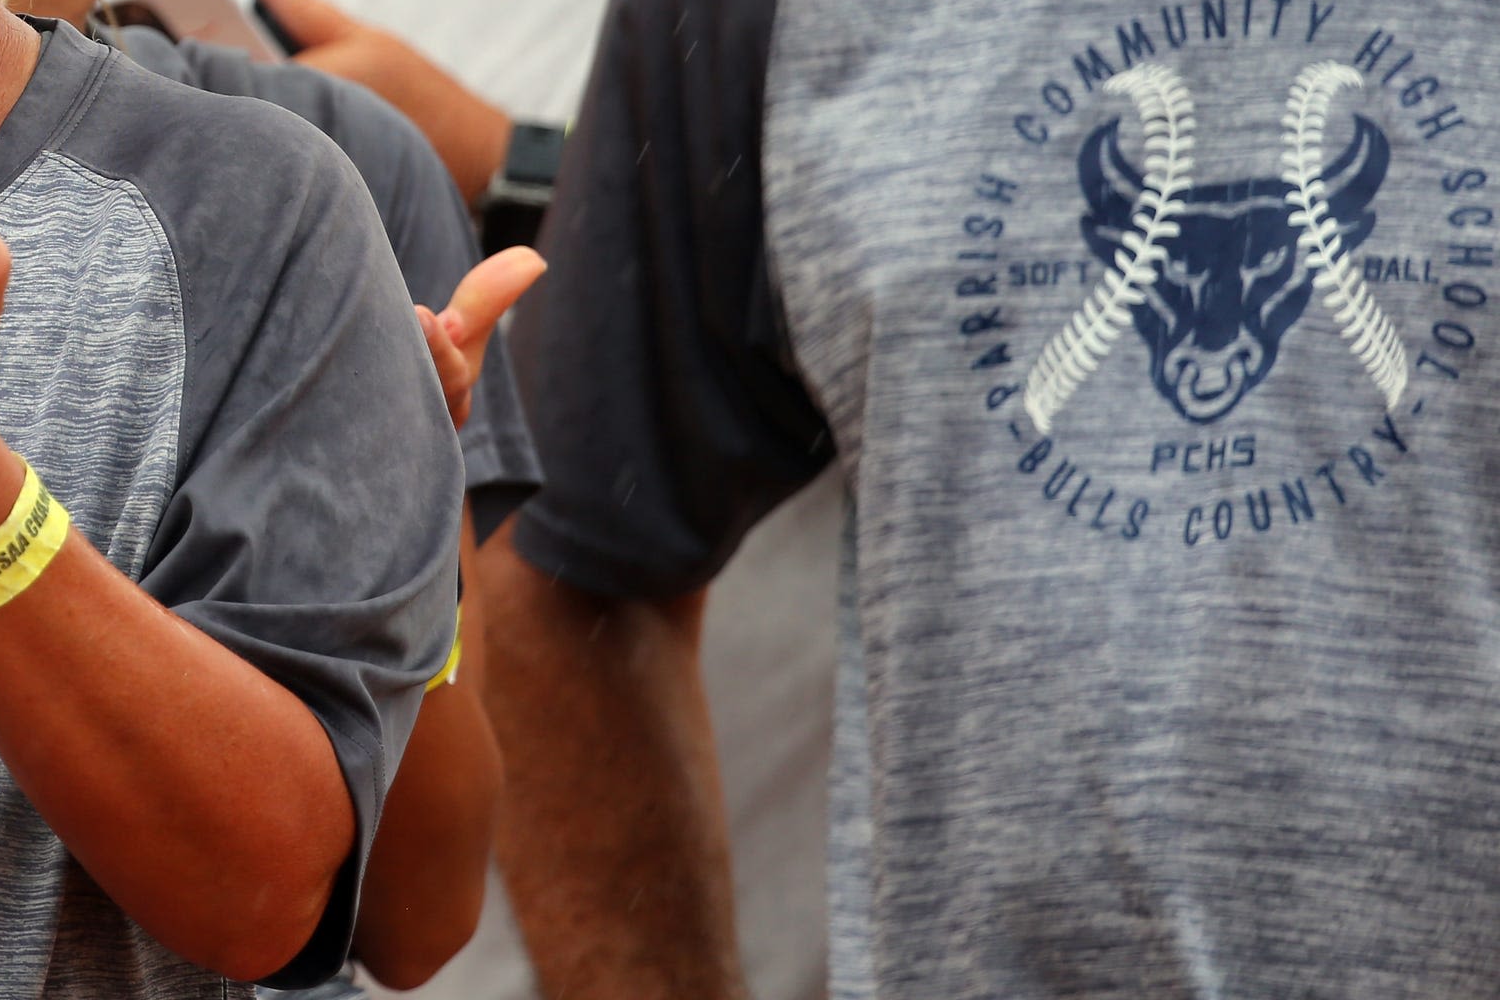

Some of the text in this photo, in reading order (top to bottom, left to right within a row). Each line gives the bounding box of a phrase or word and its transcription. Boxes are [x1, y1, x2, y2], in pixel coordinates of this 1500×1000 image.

[956, 173, 1017, 411] PARRISH
[1353, 28, 1465, 141] HIGH
[1416, 168, 1493, 380] SCHOOL
[1008, 257, 1440, 287] SOFT BALL
[1017, 416, 1410, 547] BULLS COUNTRY
[1150, 435, 1257, 475] PCHS
